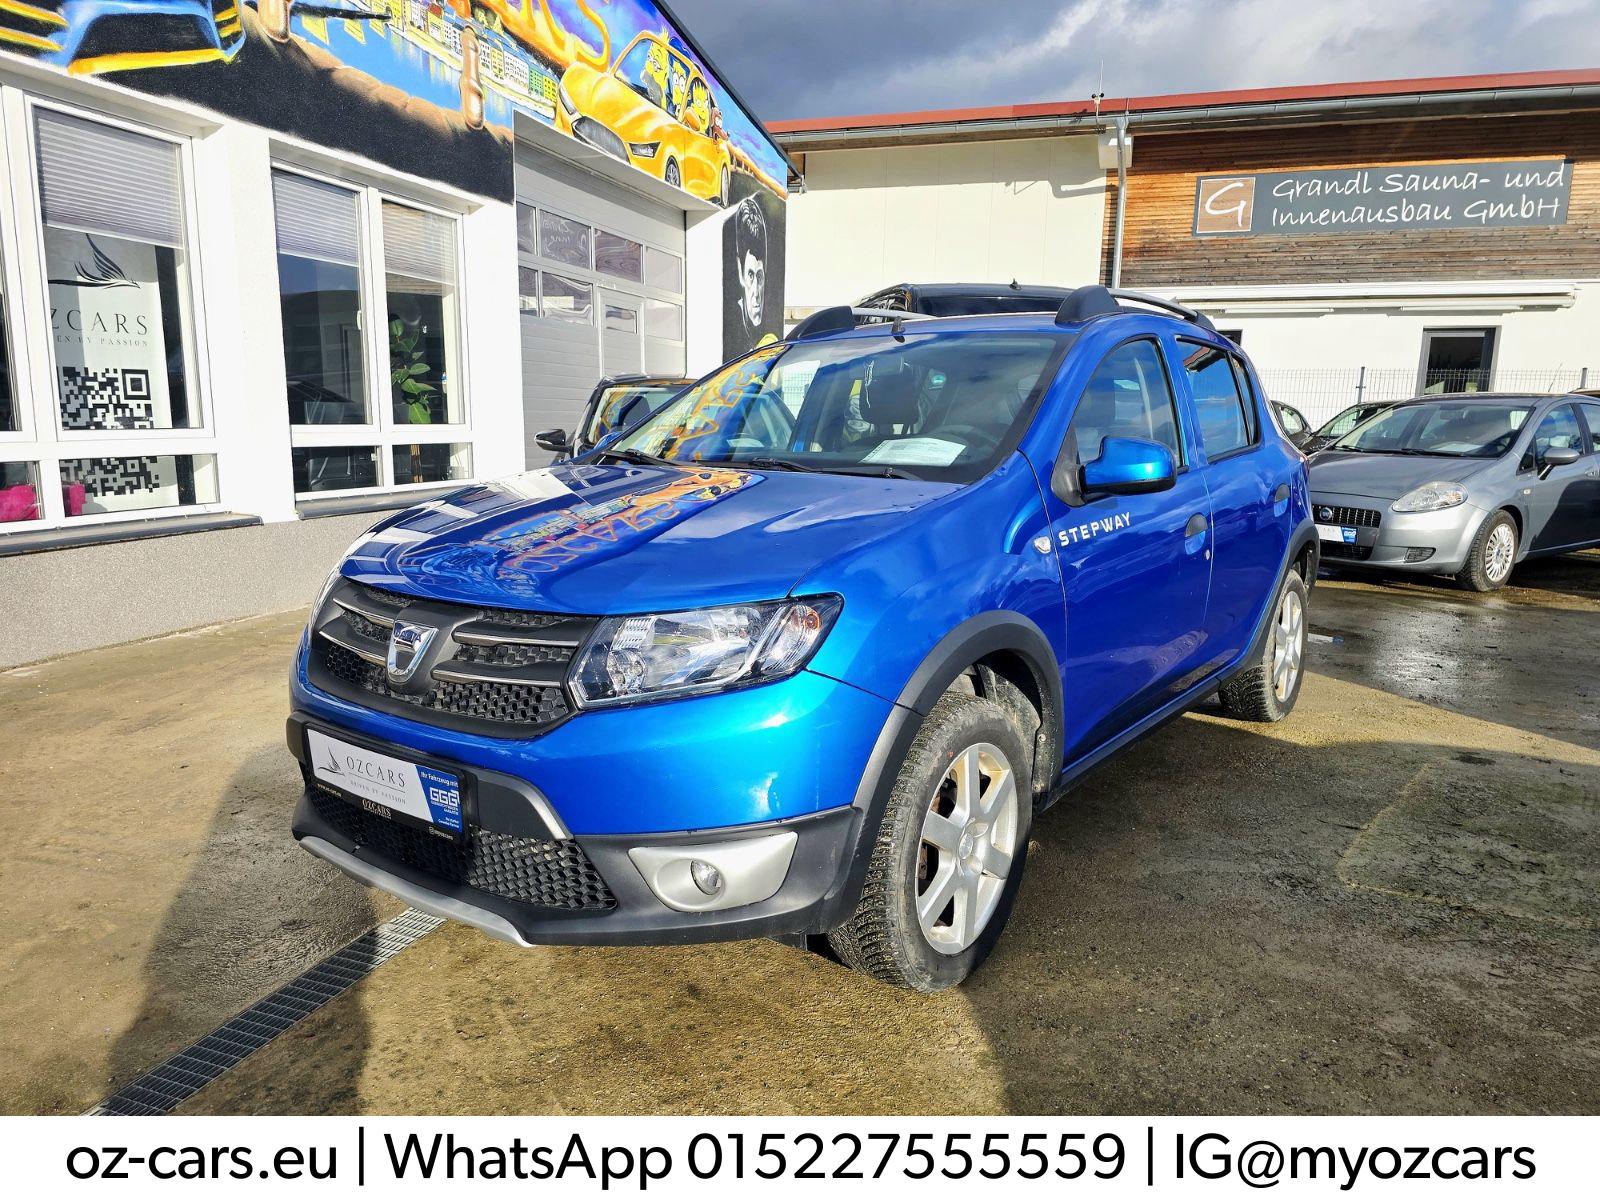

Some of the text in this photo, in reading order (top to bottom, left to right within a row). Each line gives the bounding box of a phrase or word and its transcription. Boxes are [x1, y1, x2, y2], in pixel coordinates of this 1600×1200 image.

[1272, 170, 1372, 201] Grandl
[1504, 166, 1565, 189] und
[1272, 197, 1561, 228] Innenausbau GmbH
[50, 308, 148, 336] ZCARS
[100, 337, 148, 347] PASSION
[1058, 511, 1131, 547] STEPWAY
[346, 756, 406, 788] OZCARS
[429, 787, 460, 808] GGG
